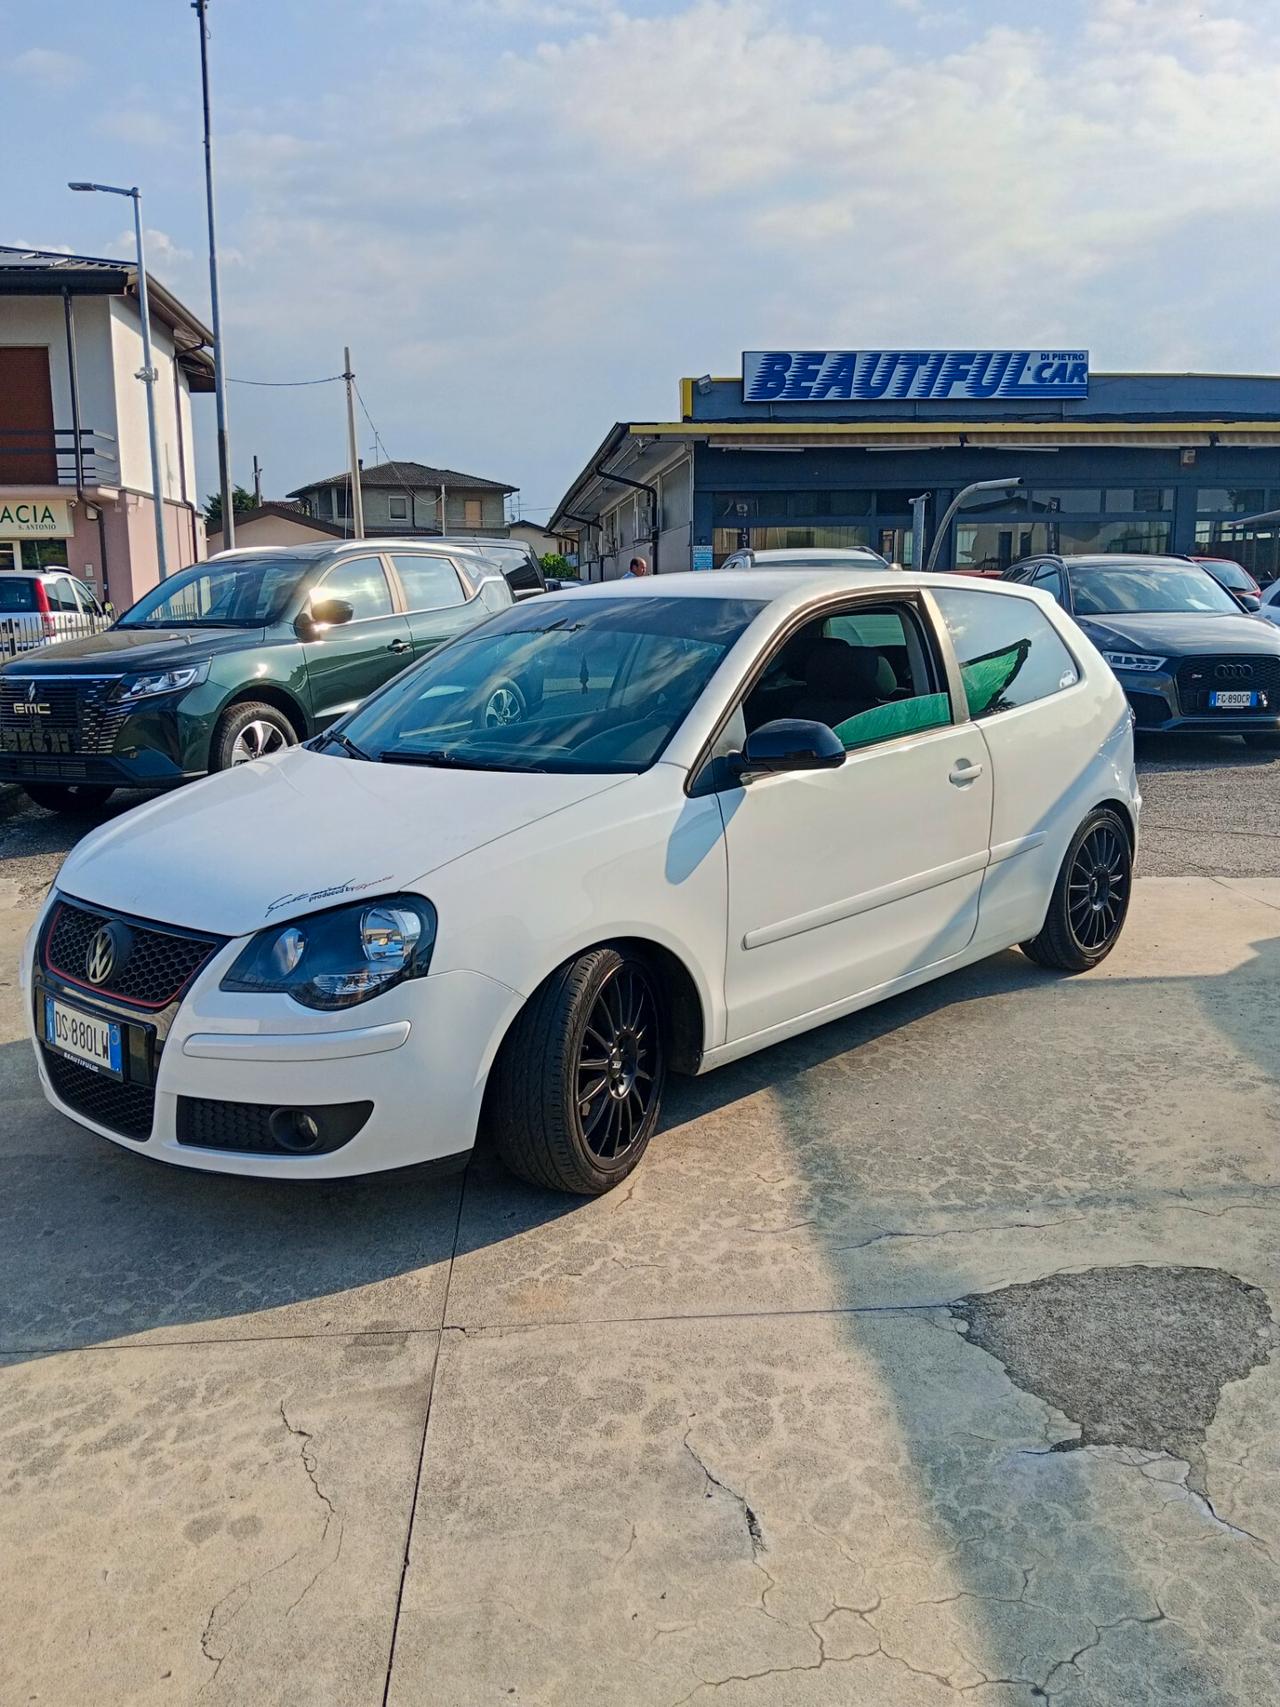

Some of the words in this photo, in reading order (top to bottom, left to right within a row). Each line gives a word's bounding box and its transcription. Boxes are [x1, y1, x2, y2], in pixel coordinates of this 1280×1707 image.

[1040, 353, 1050, 361] DI
[1052, 353, 1085, 361] PIETRO
[746, 352, 1031, 399] BEAUTIFUL
[1032, 362, 1088, 384] CAR
[0, 504, 55, 524] ACIA
[26, 523, 57, 531] ANTONIO
[309, 885, 345, 903] produced
